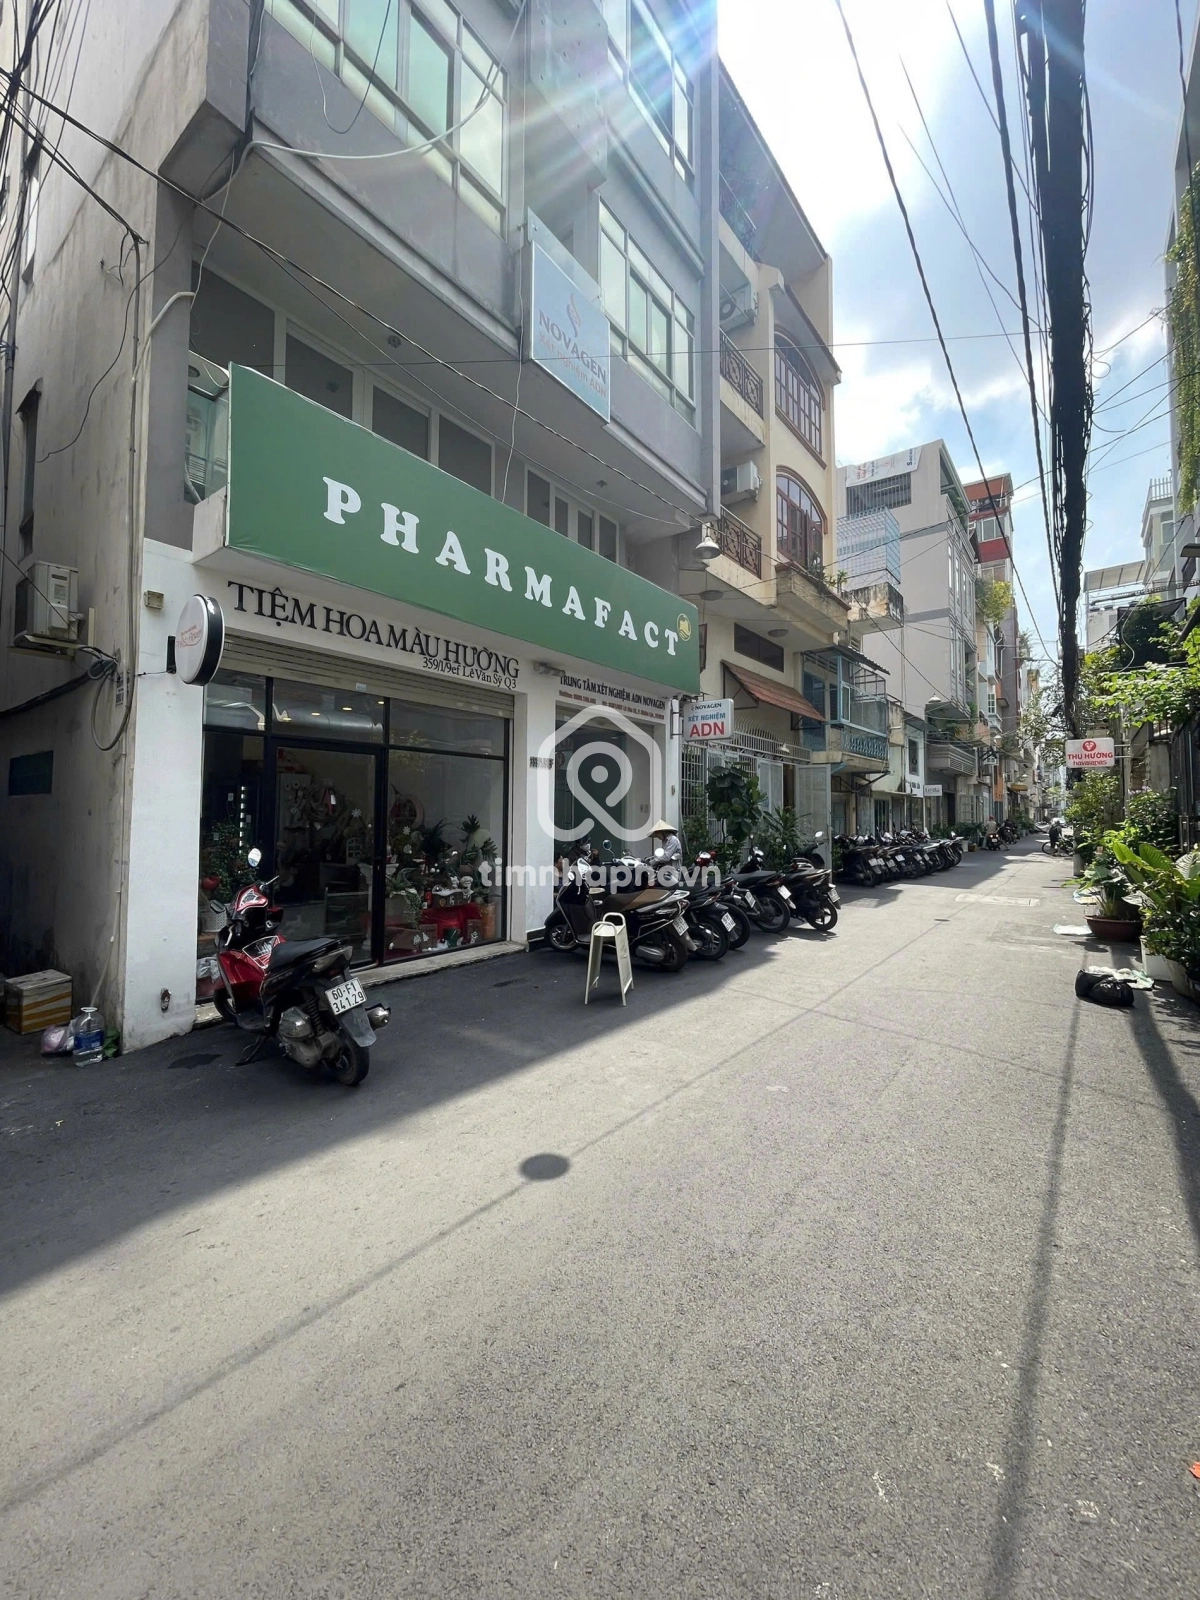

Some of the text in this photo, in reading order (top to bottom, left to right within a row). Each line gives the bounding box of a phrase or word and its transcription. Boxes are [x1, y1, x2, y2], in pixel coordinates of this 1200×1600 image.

[539, 310, 606, 384] NOVAGEN
[322, 477, 679, 656] PHARMAFACT
[227, 581, 520, 678] TIỆM HOA MÀU HƯỜNG
[422, 657, 461, 678] 359/1/9ef
[462, 666, 475, 678] Lê
[475, 669, 492, 683] Văn
[504, 677, 517, 690] Q3
[560, 675, 581, 689] TRUNG
[582, 678, 596, 693] TÂM
[596, 682, 609, 695] XÉT
[608, 688, 630, 702] NGHIỆM
[631, 694, 642, 703] ADN
[642, 696, 666, 710] NOVAGEN
[687, 712, 726, 722] XÉT NGHIỆM
[690, 721, 725, 738] ADN
[332, 982, 357, 1000] 60-F1
[332, 991, 365, 1013] 341.29
